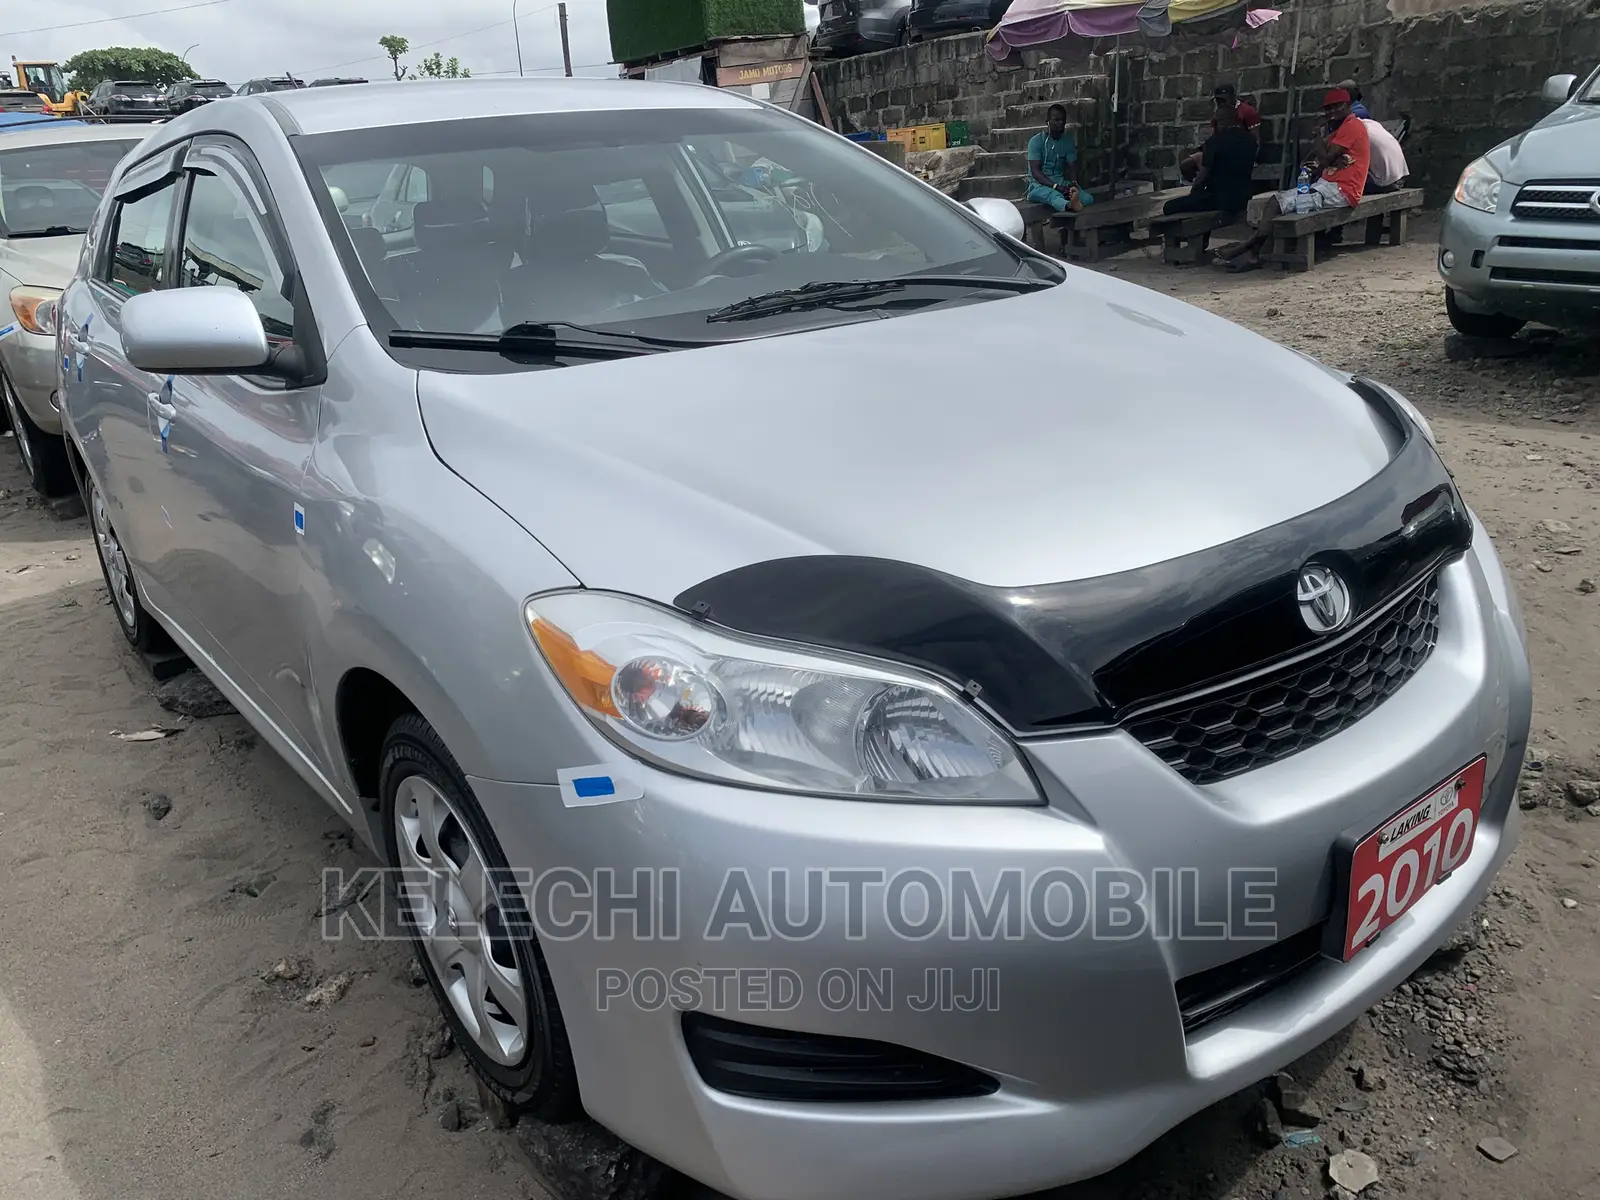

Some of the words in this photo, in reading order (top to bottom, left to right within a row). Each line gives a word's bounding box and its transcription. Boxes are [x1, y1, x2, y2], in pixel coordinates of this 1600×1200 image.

[763, 64, 793, 77] MOTORS
[1390, 804, 1432, 842] LAKING
[1351, 808, 1474, 950] 2010
